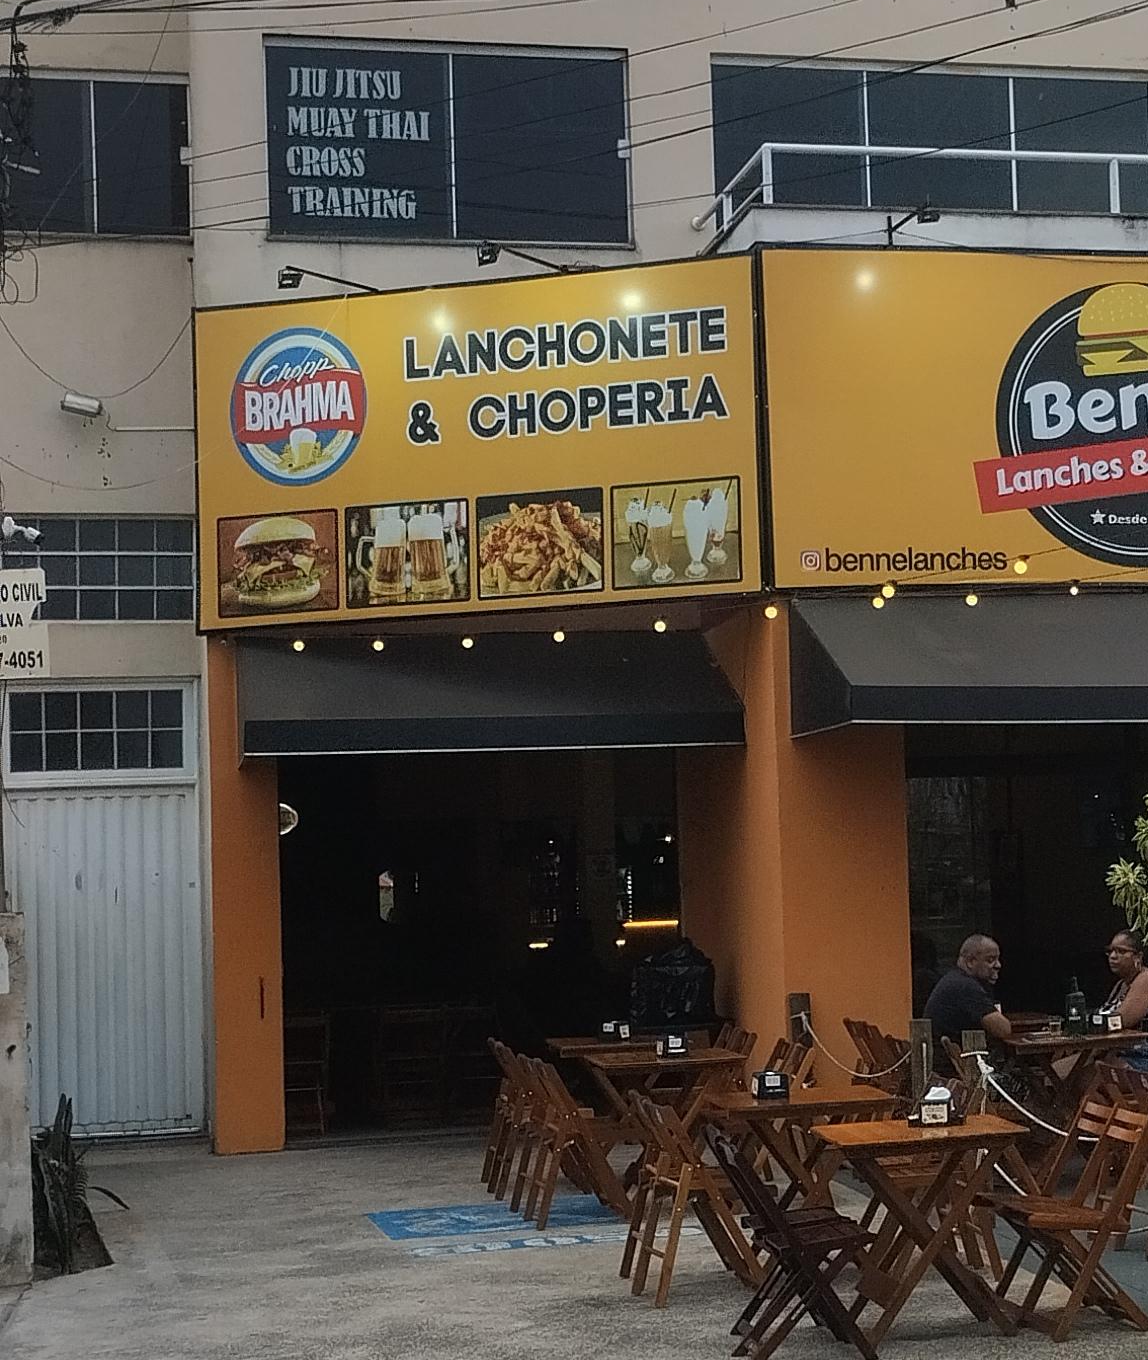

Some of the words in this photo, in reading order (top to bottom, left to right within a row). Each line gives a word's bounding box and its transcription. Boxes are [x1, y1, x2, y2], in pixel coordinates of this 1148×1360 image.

[288, 67, 327, 97] JIU
[333, 69, 401, 100] JITSU
[287, 107, 358, 138] MUAY
[364, 109, 431, 141] THAI
[286, 147, 366, 177] CROSS
[288, 187, 417, 220] TRAINING
[403, 306, 727, 379] LANCHONETE
[260, 357, 335, 387] Chopp
[245, 381, 355, 431] BRAHMA
[407, 401, 440, 444] &
[468, 375, 729, 440] CHOPERIA
[996, 456, 1125, 496] Lanches
[1108, 514, 1148, 525] Desde
[825, 546, 1008, 572] bennelanches
[12, 582, 43, 602] CIVIL
